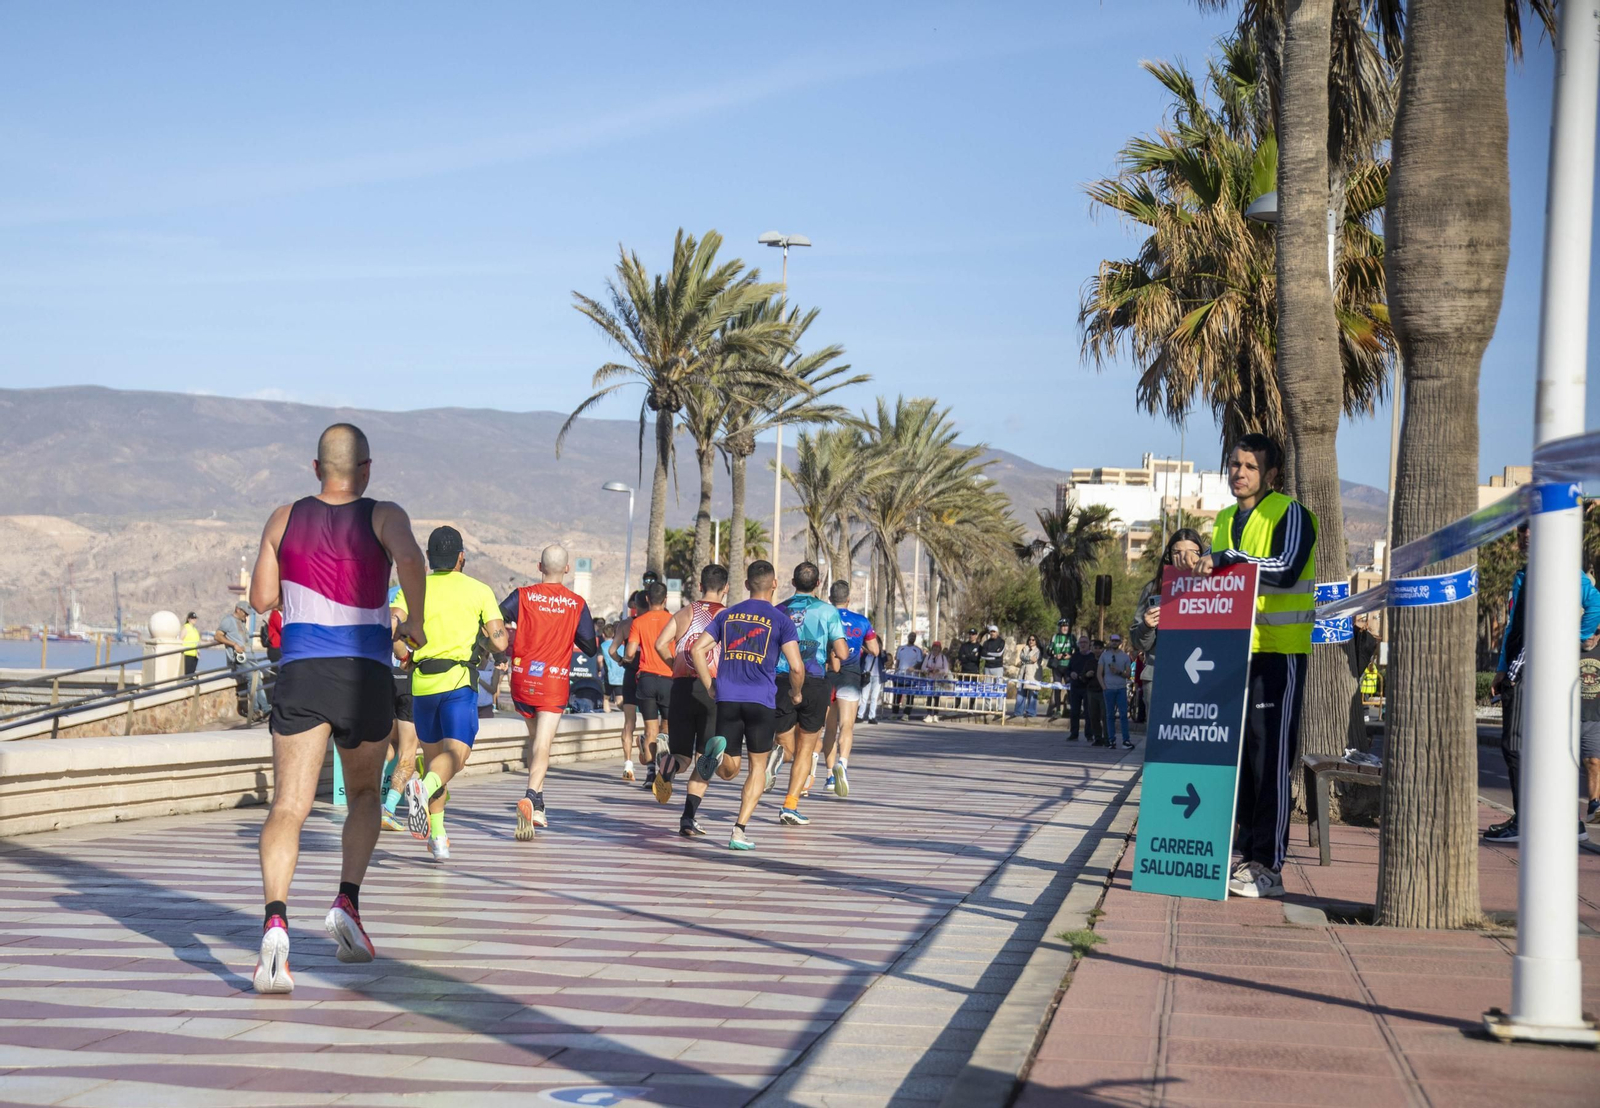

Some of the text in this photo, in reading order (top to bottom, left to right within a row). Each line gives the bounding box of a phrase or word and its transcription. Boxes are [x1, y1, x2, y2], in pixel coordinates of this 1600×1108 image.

[1171, 572, 1245, 596] ¡ATENCIÓN
[1179, 594, 1234, 614] DESVÍO!
[728, 613, 772, 626] MISTRAL
[724, 652, 764, 665] LEGION
[1172, 702, 1219, 720] MEDIO
[1158, 721, 1229, 743] MARATÓN
[1150, 837, 1214, 857] CARRERA
[1140, 858, 1221, 880] SALUDABLE
